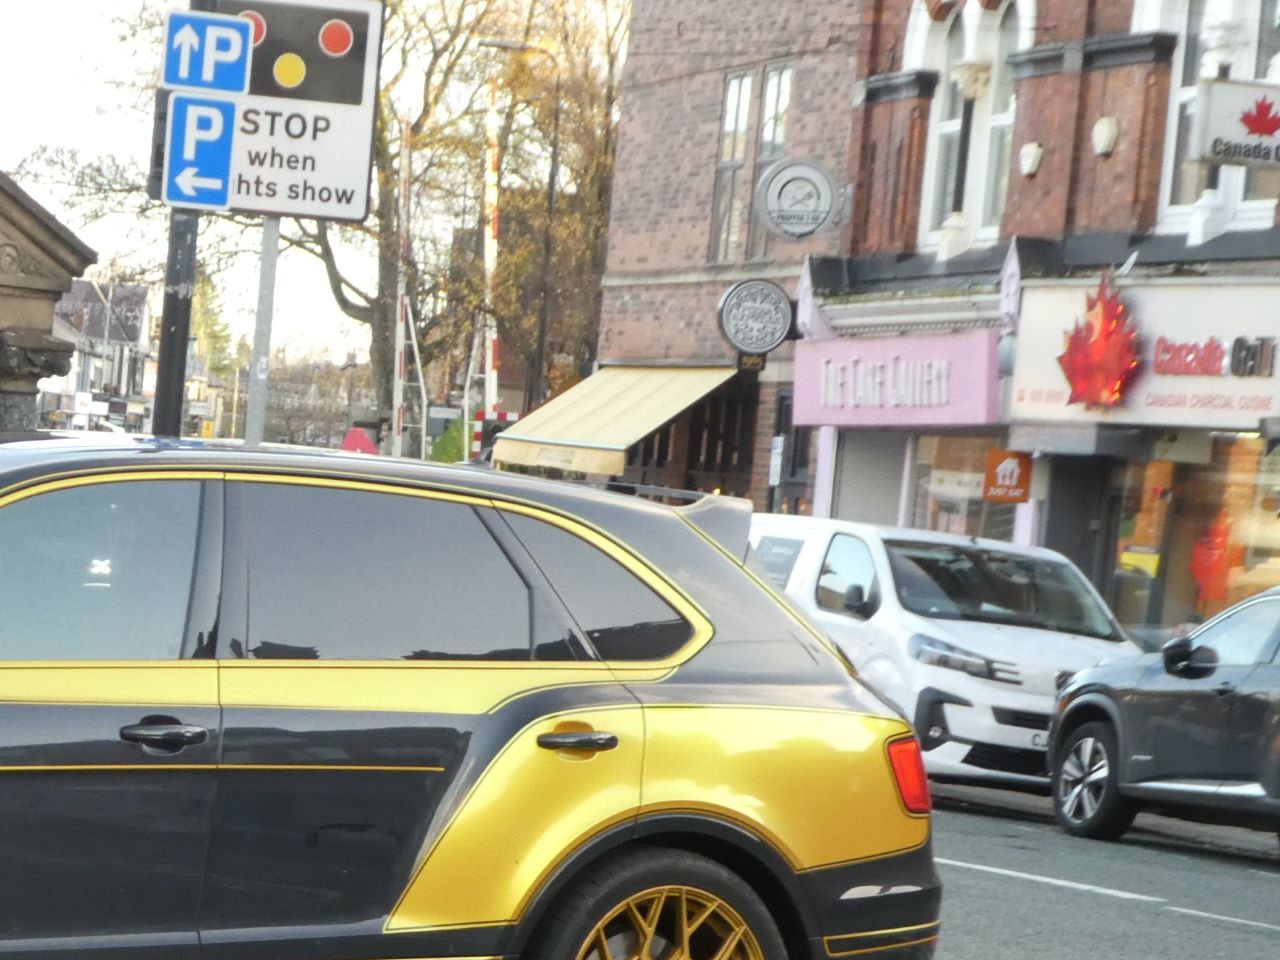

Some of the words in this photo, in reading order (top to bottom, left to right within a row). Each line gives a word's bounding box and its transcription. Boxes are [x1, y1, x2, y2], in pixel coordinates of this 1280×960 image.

[201, 25, 243, 82] P
[183, 104, 223, 161] P
[240, 108, 331, 141] STOP
[248, 147, 316, 171] when
[1212, 136, 1271, 160] Canada
[233, 174, 277, 197] hts
[288, 180, 356, 204] show
